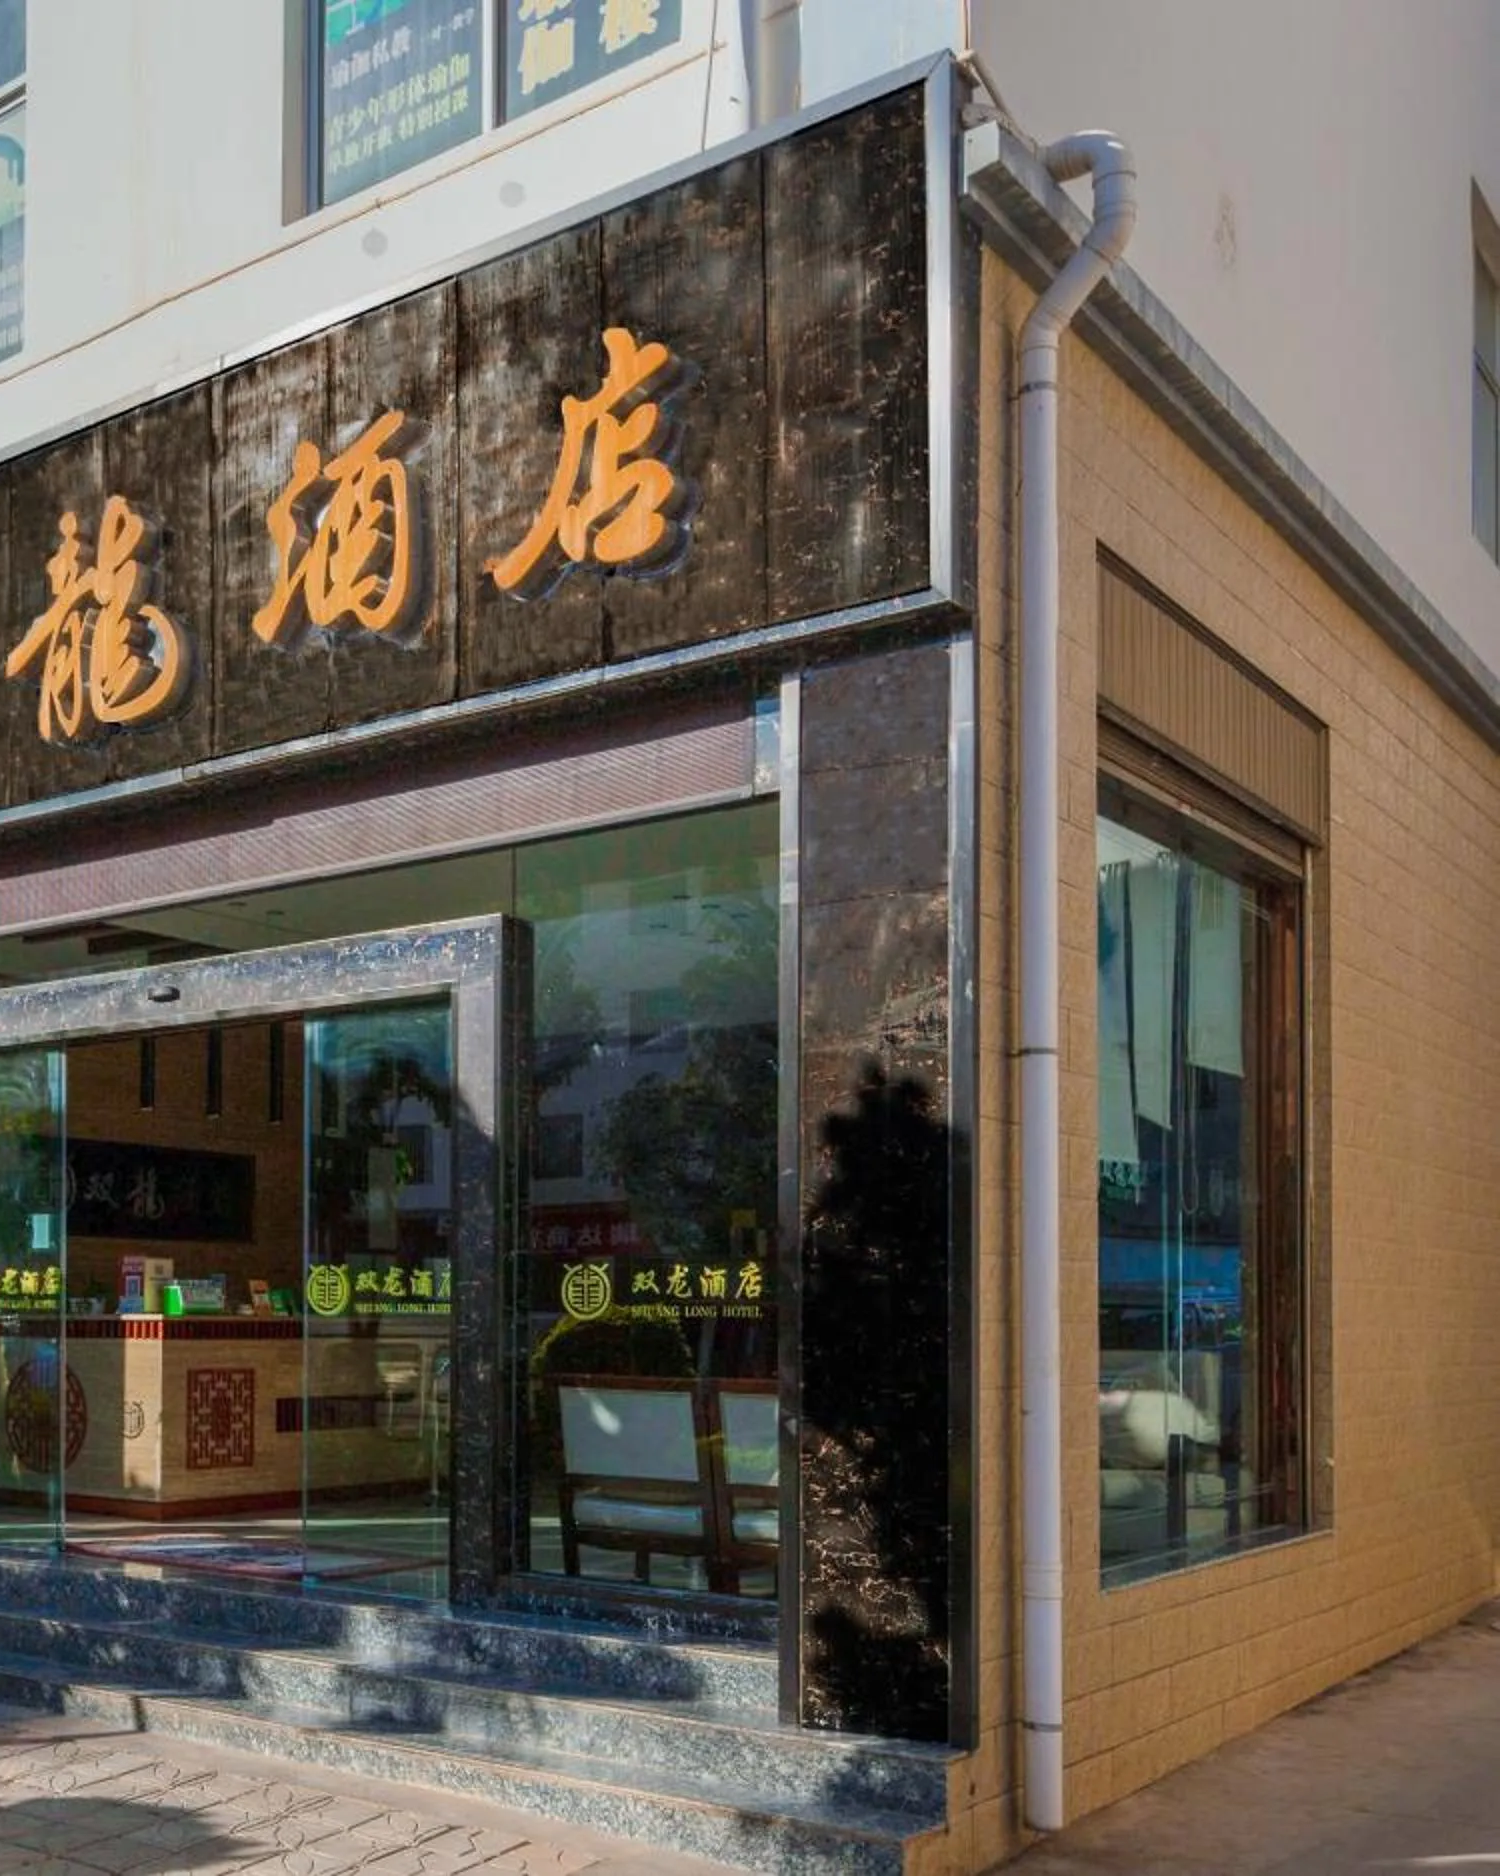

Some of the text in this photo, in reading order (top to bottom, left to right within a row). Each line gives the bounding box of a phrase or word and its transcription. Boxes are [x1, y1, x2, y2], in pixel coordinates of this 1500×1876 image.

[630, 1261, 763, 1300] 双龙酒店
[684, 1305, 717, 1318] LONG
[722, 1305, 762, 1318] HOTEL
